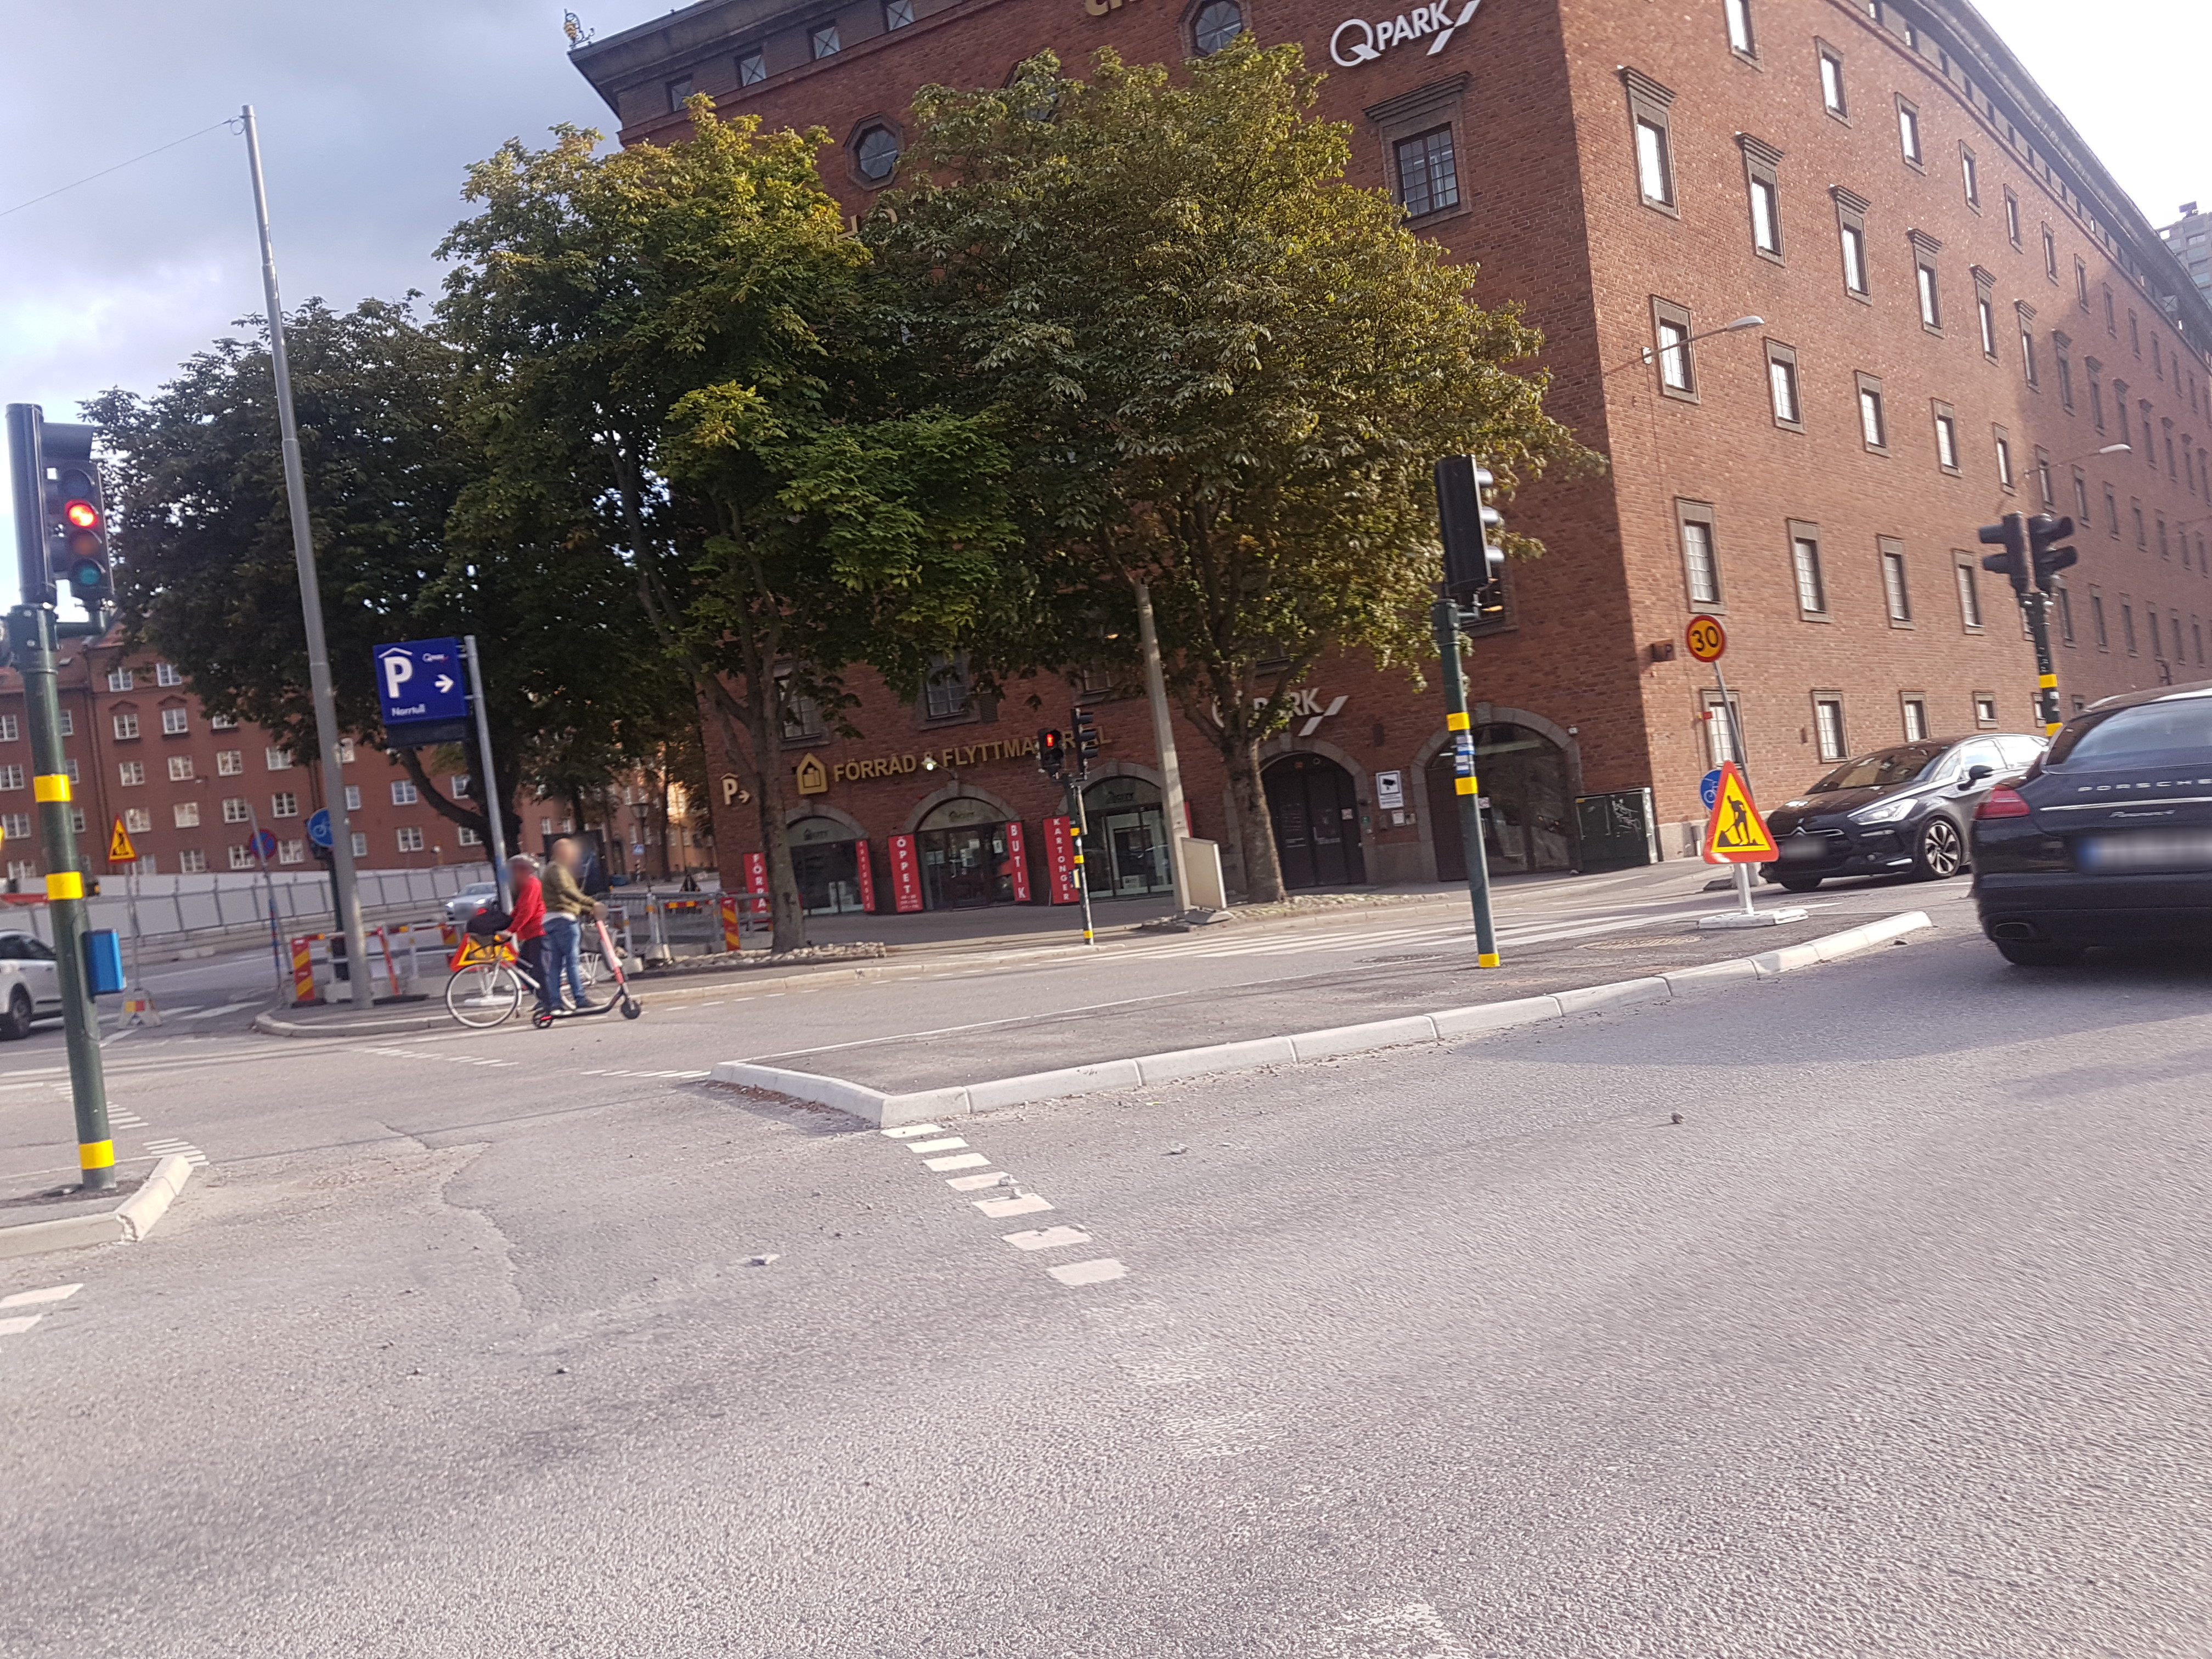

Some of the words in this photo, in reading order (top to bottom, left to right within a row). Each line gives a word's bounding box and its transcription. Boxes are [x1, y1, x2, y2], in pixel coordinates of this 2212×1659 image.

[1692, 625, 1719, 652] 30
[385, 656, 413, 698] P
[833, 753, 917, 782] FÖRRÅD
[2078, 778, 2212, 792] PORSCHE
[722, 778, 738, 805] P
[896, 836, 911, 894] ÖPPET
[1011, 825, 1026, 899] BUTIK
[1053, 818, 1069, 900] KARTONGER
